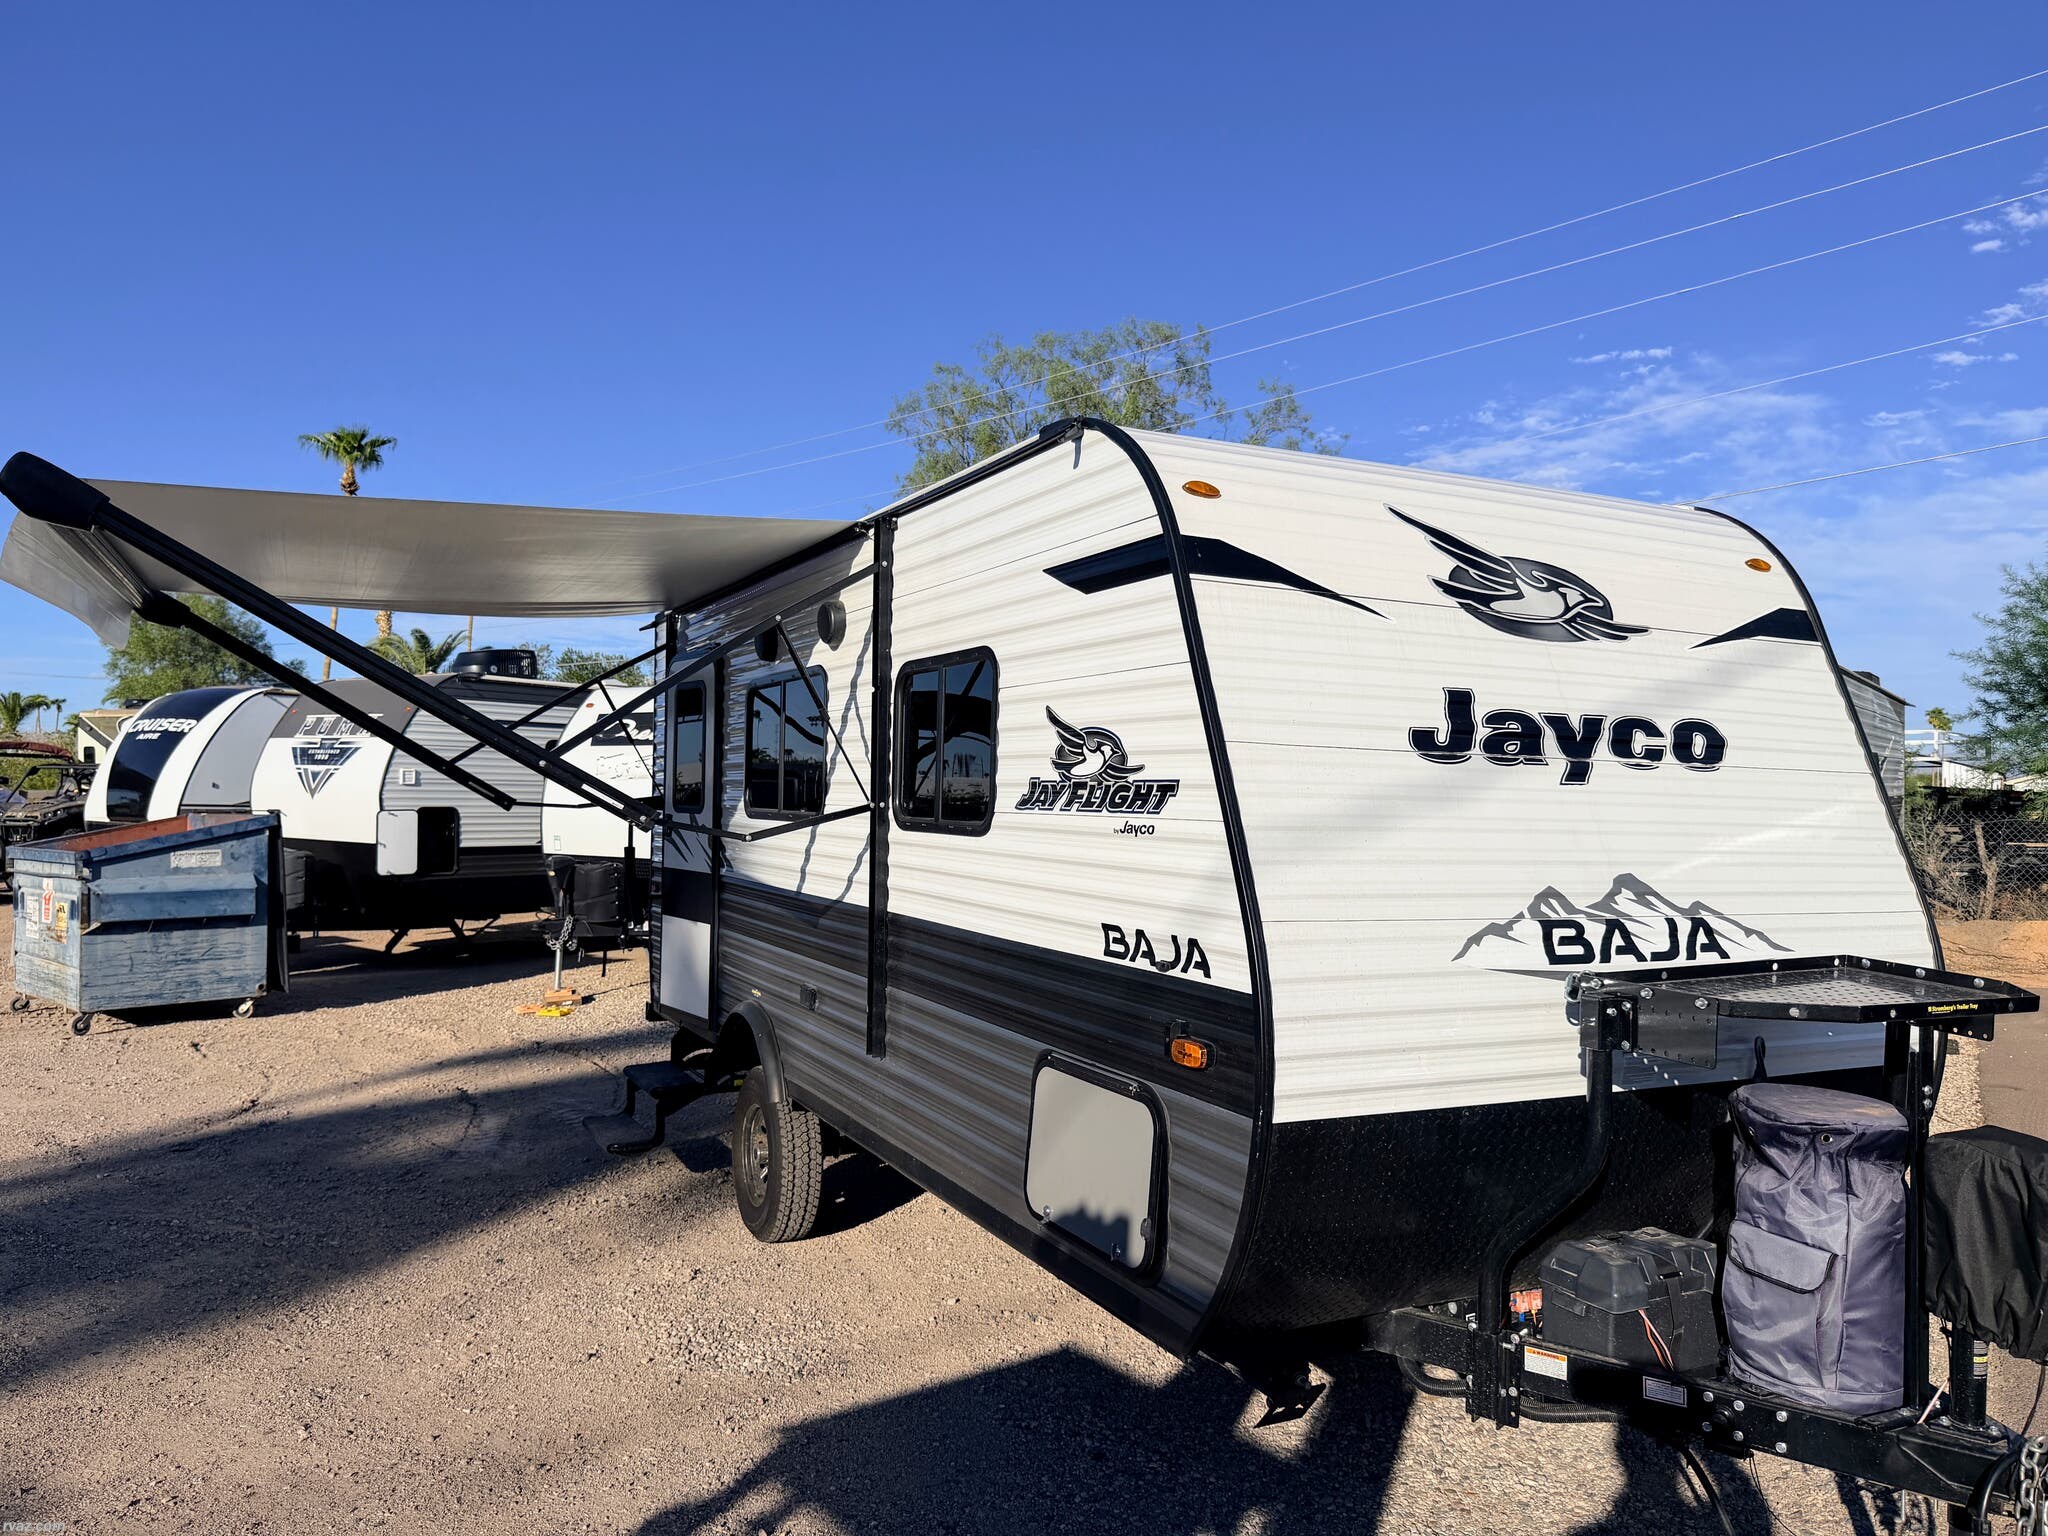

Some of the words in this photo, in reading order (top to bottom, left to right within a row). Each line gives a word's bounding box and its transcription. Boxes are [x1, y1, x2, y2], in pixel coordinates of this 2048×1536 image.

[127, 718, 198, 733] CRUISER
[294, 714, 384, 738] PUM
[1408, 687, 1728, 785] Jayco
[1015, 777, 1069, 811] JAY
[1059, 778, 1180, 815] FLIGHT
[1119, 820, 1155, 838] Jayco
[1101, 922, 1211, 979] BAJA
[1538, 917, 1731, 966] BAJA
[1537, 1351, 1560, 1360] WARNING
